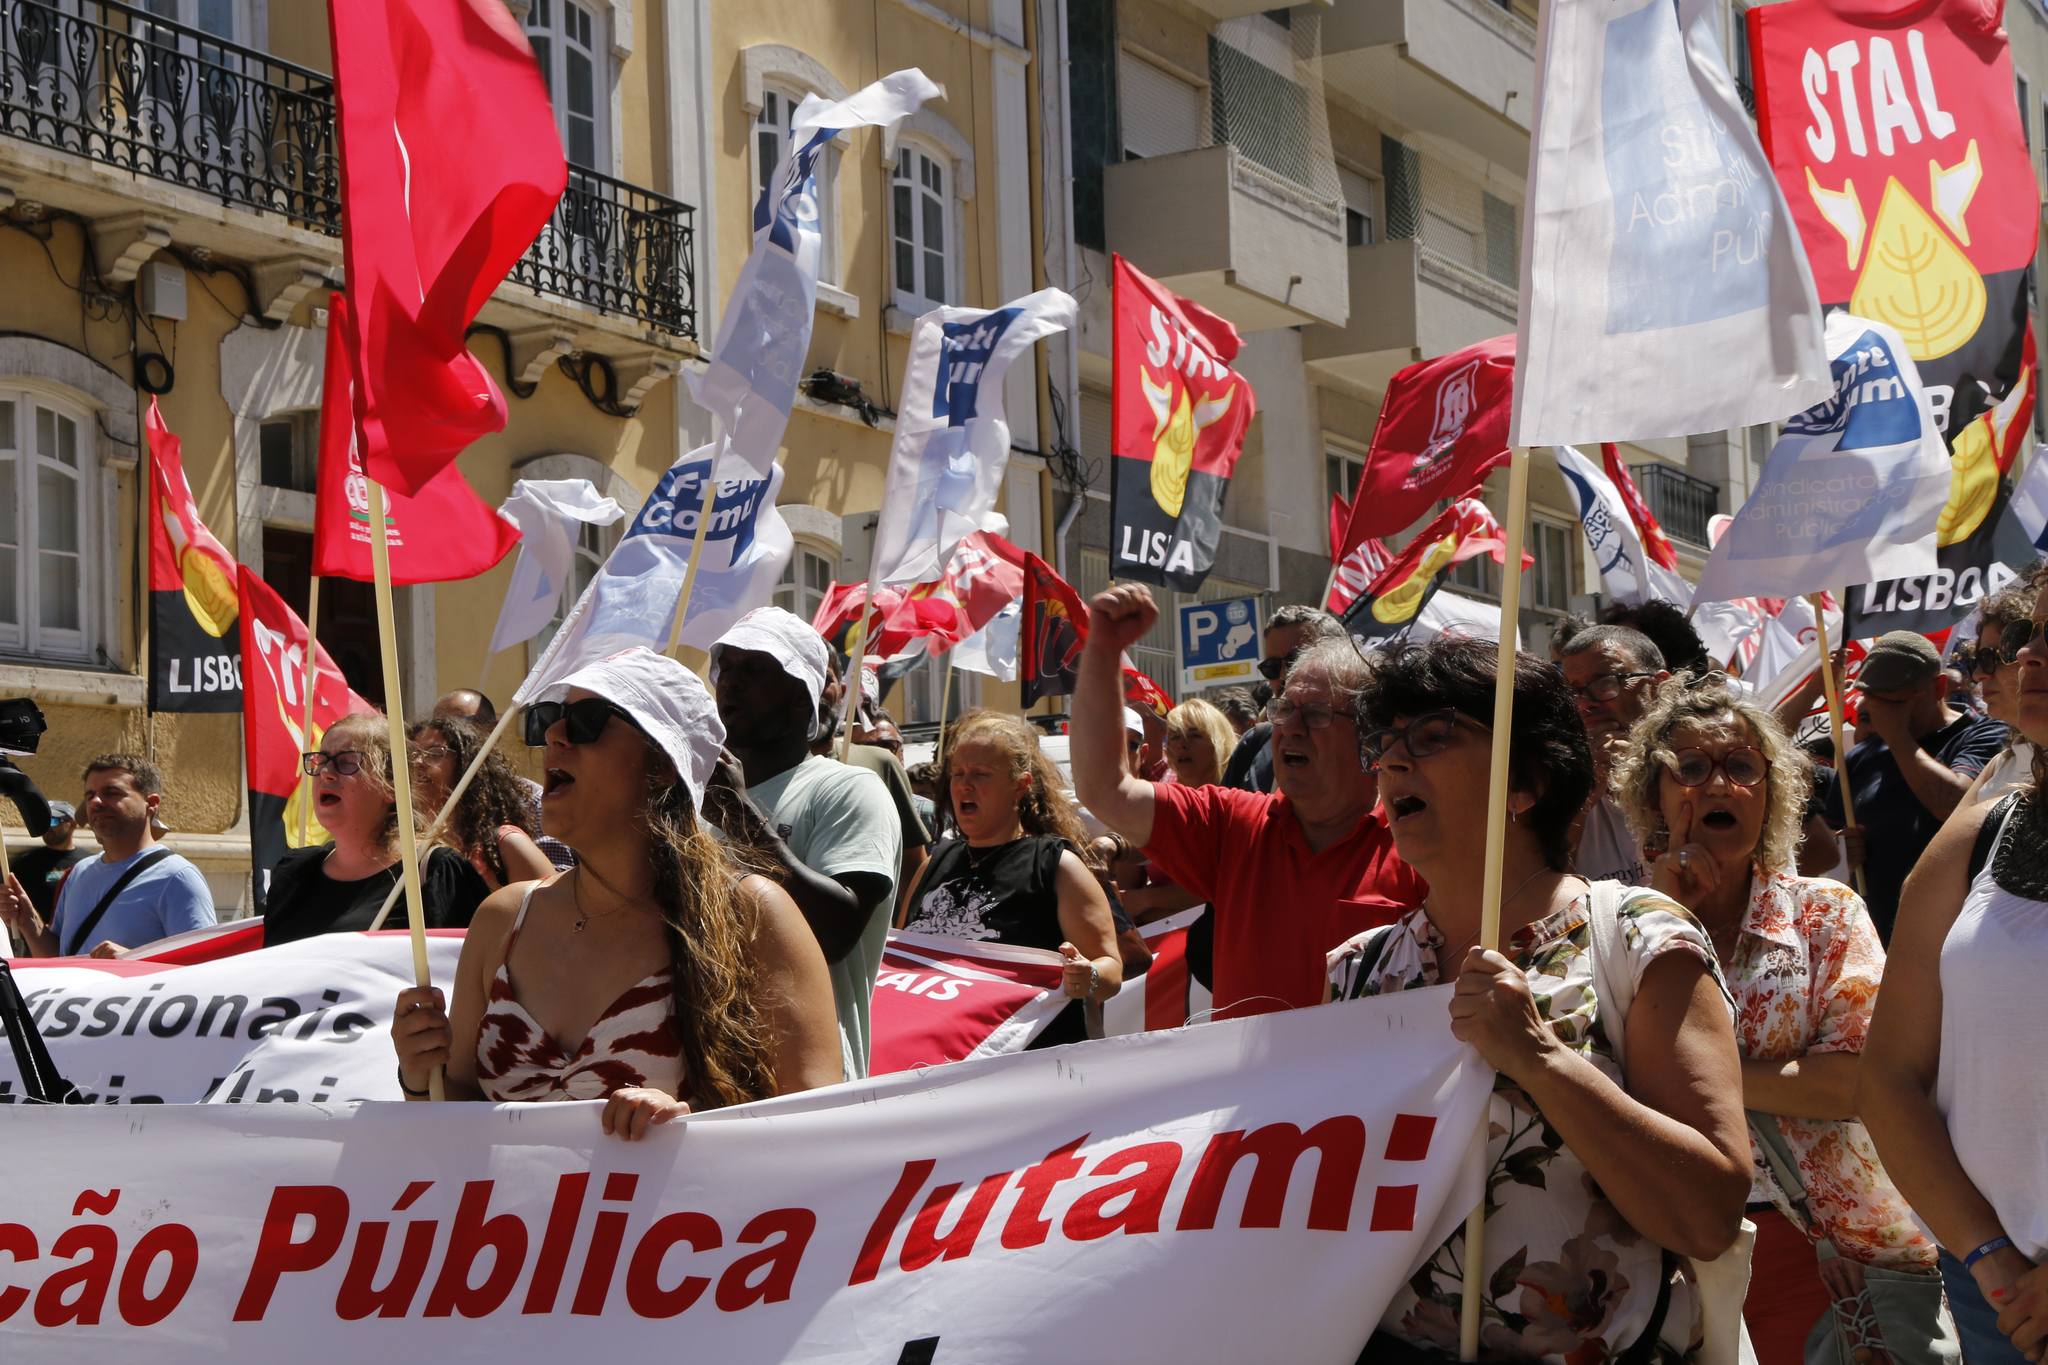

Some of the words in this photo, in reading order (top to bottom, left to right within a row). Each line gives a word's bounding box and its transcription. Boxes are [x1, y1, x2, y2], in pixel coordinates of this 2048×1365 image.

[1802, 29, 1956, 163] STAL
[1862, 561, 2019, 615] LISBOA
[1189, 611, 1219, 655] P
[876, 969, 975, 1001] AIS
[233, 1172, 817, 1321] Pública
[848, 1113, 1437, 1286] lutam:
